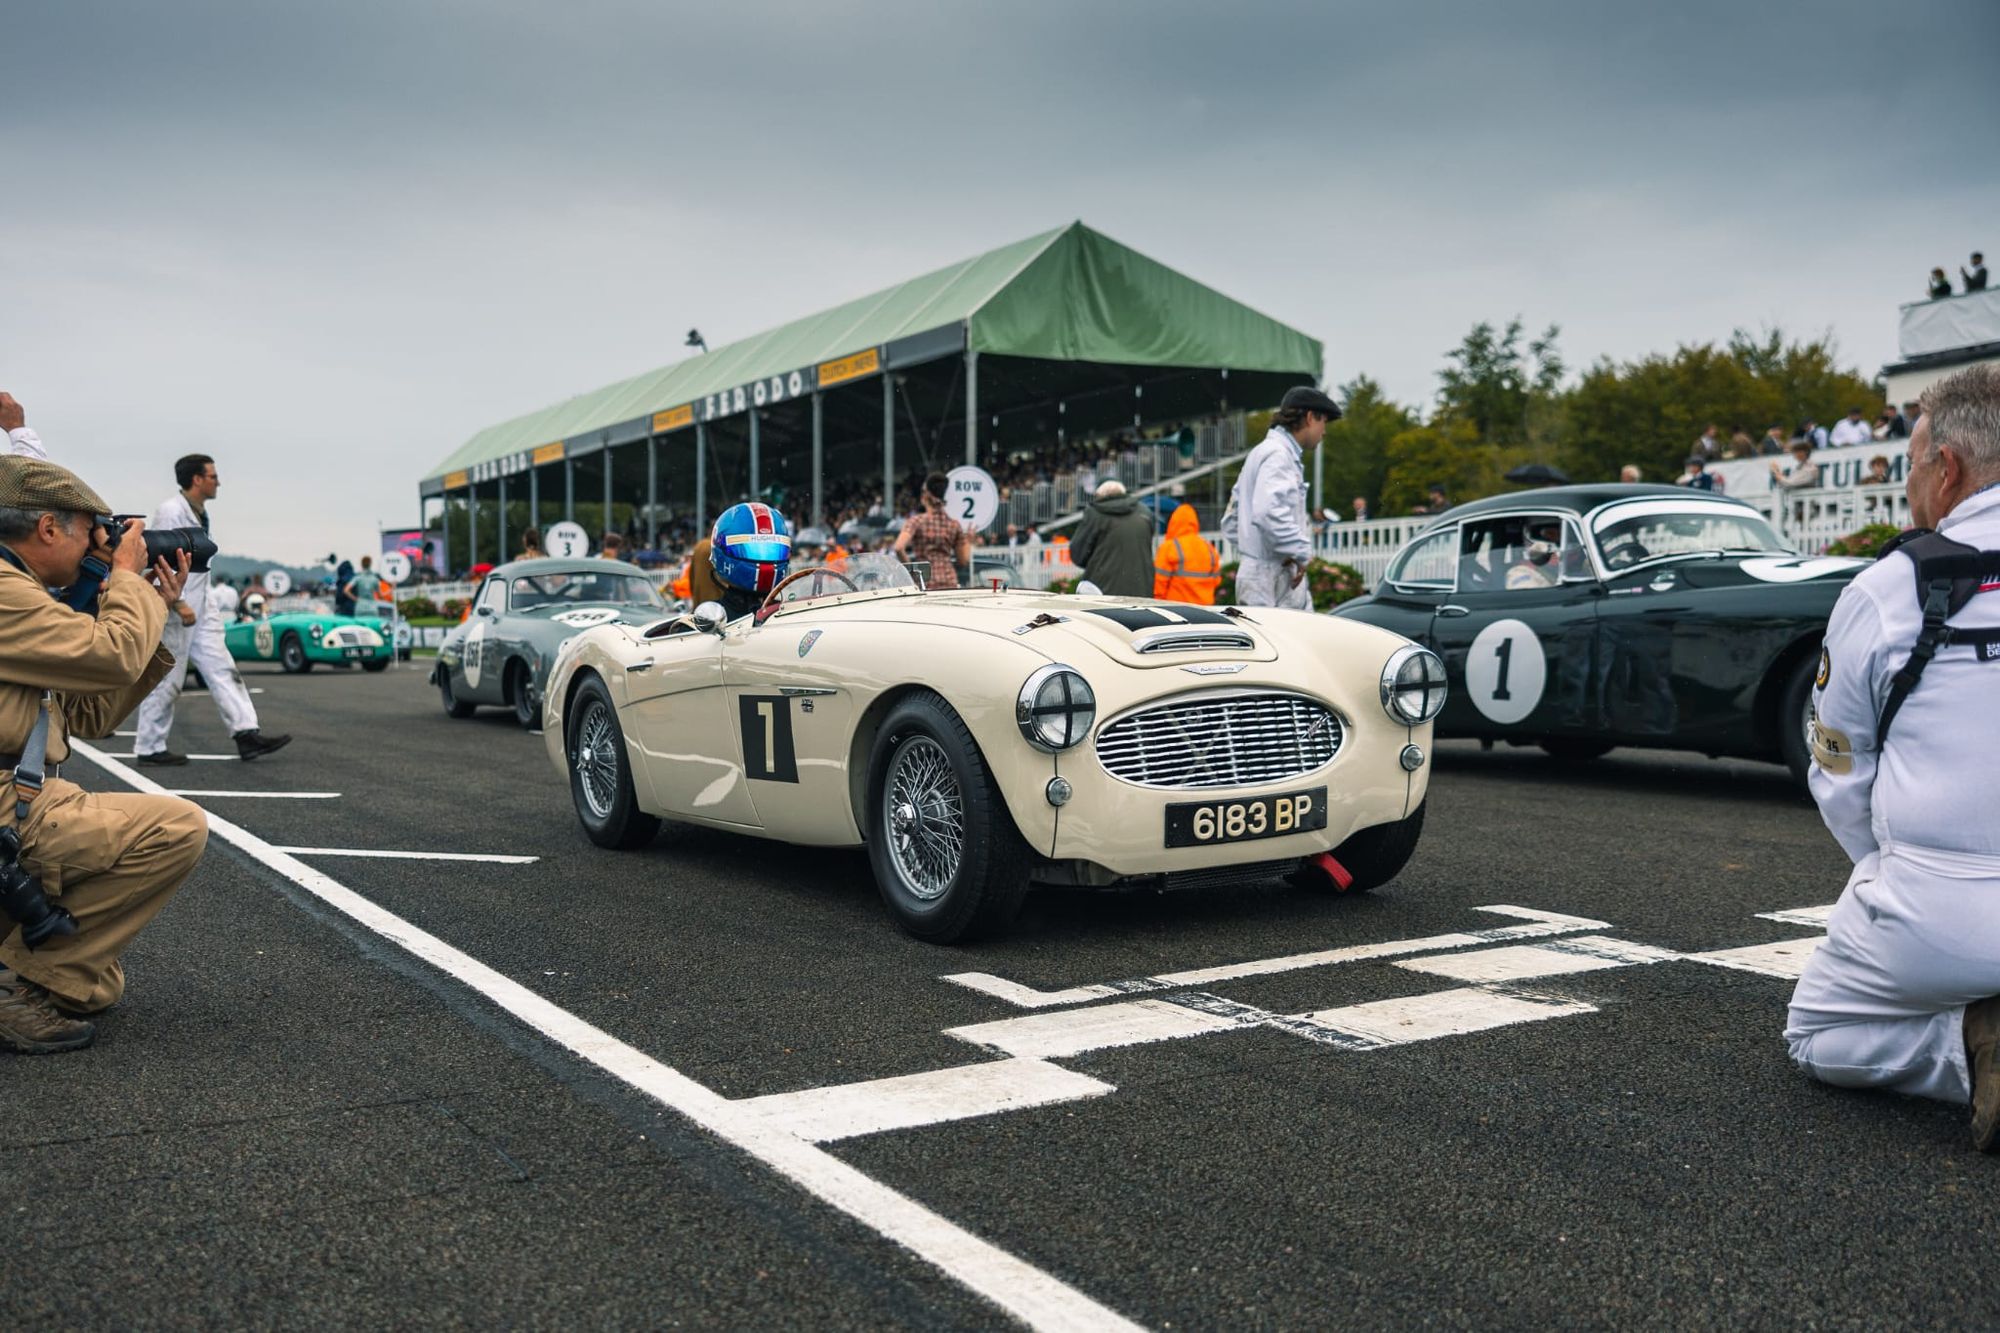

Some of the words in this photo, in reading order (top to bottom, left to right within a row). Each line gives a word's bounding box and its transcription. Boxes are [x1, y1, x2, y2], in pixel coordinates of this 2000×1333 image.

[705, 370, 803, 421] FERODO
[955, 481, 983, 492] ROW
[962, 496, 975, 519] 2
[563, 541, 572, 557] 3
[1491, 637, 1513, 701] 1
[757, 701, 775, 773] 1
[1193, 802, 1267, 840] 6183
[1275, 795, 1312, 832] BP
